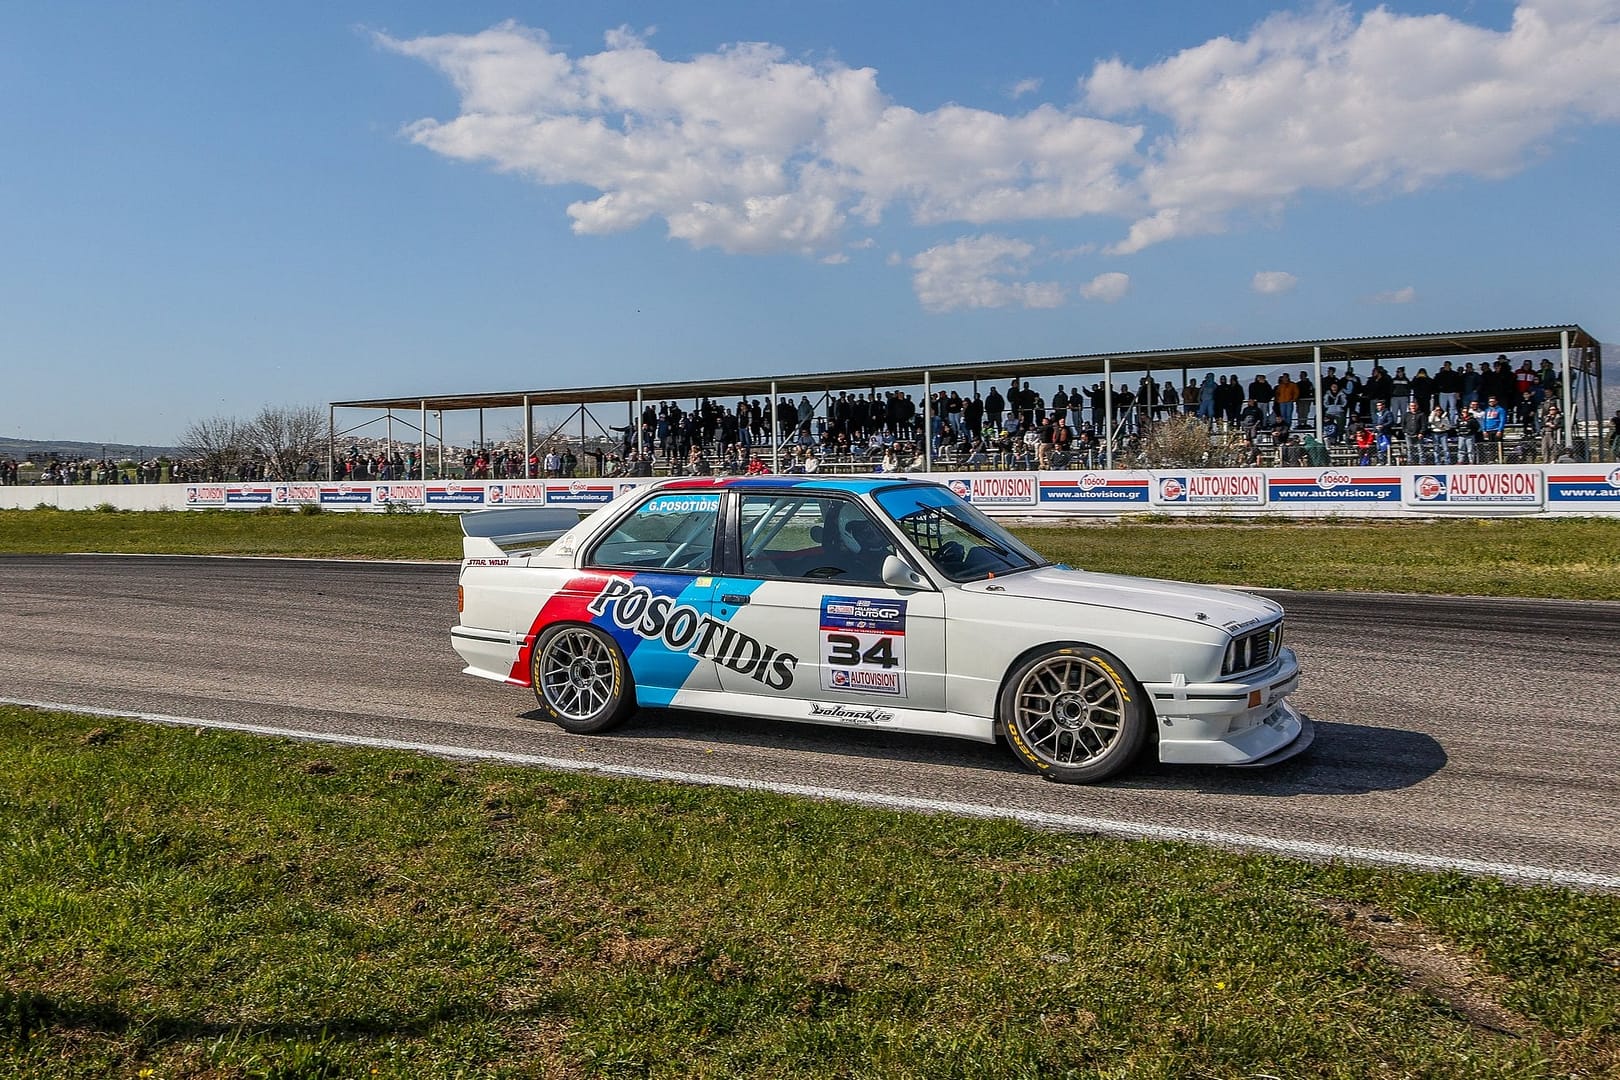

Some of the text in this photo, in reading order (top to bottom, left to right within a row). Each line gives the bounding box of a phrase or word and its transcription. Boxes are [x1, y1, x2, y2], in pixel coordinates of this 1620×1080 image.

[1083, 478, 1106, 486] 10600
[1323, 475, 1349, 483] 10600
[1450, 474, 1535, 495] AUTOVISION
[505, 485, 542, 498] AUTOVISION
[973, 479, 1032, 497] AUTOVISION
[1189, 477, 1258, 496] AUTOVISION
[551, 494, 608, 502] www.autovision.gr
[1048, 490, 1140, 500] www.autovision.gr
[1279, 489, 1391, 499] www.autovision.gr
[649, 501, 718, 511] G.POSOTIDIS
[589, 577, 800, 691] POSOTIDIS
[827, 634, 899, 669] 34
[851, 671, 897, 687] AUTOVISION
